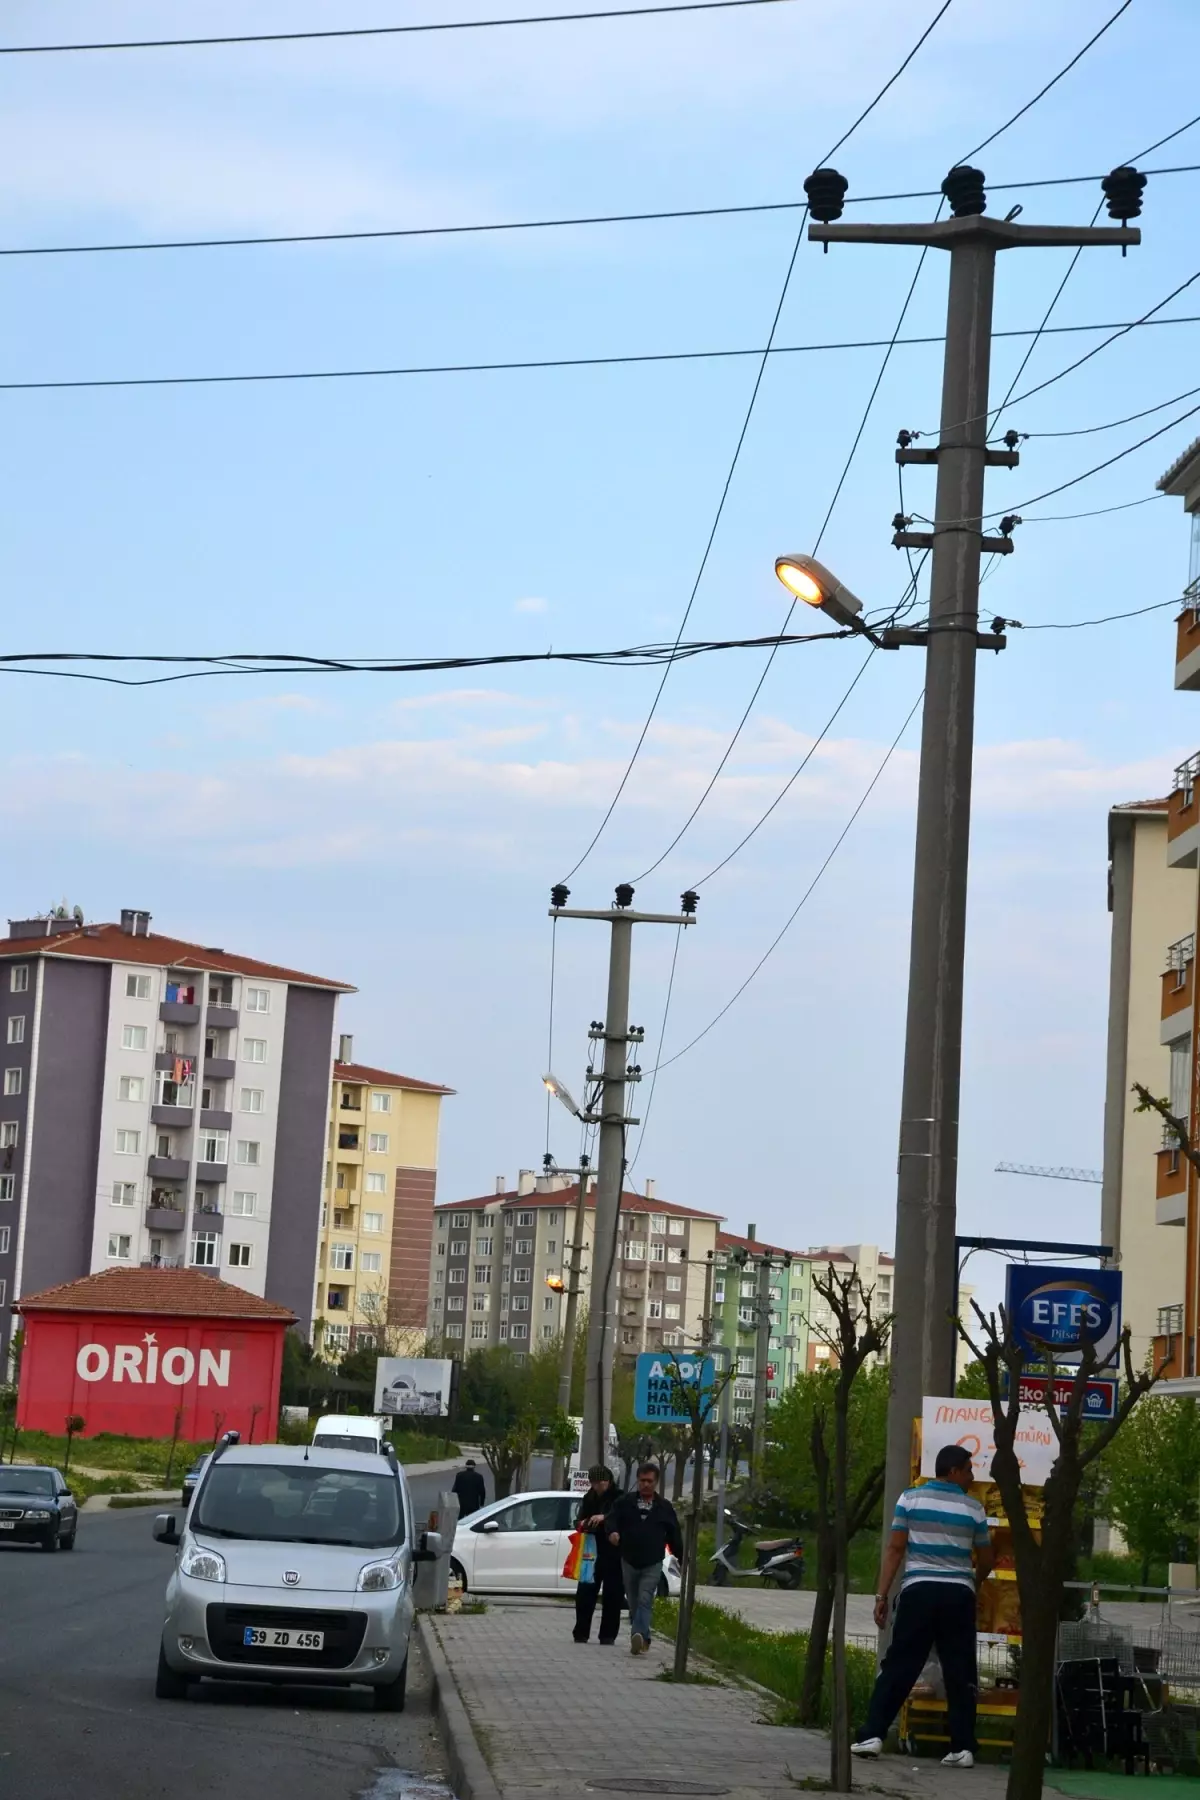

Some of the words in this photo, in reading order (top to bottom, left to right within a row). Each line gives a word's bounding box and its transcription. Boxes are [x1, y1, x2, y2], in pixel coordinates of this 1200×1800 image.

[1032, 1299, 1102, 1329] EFES
[251, 1630, 267, 1644] 59
[273, 1632, 289, 1646] ZD
[296, 1633, 321, 1648] 456
